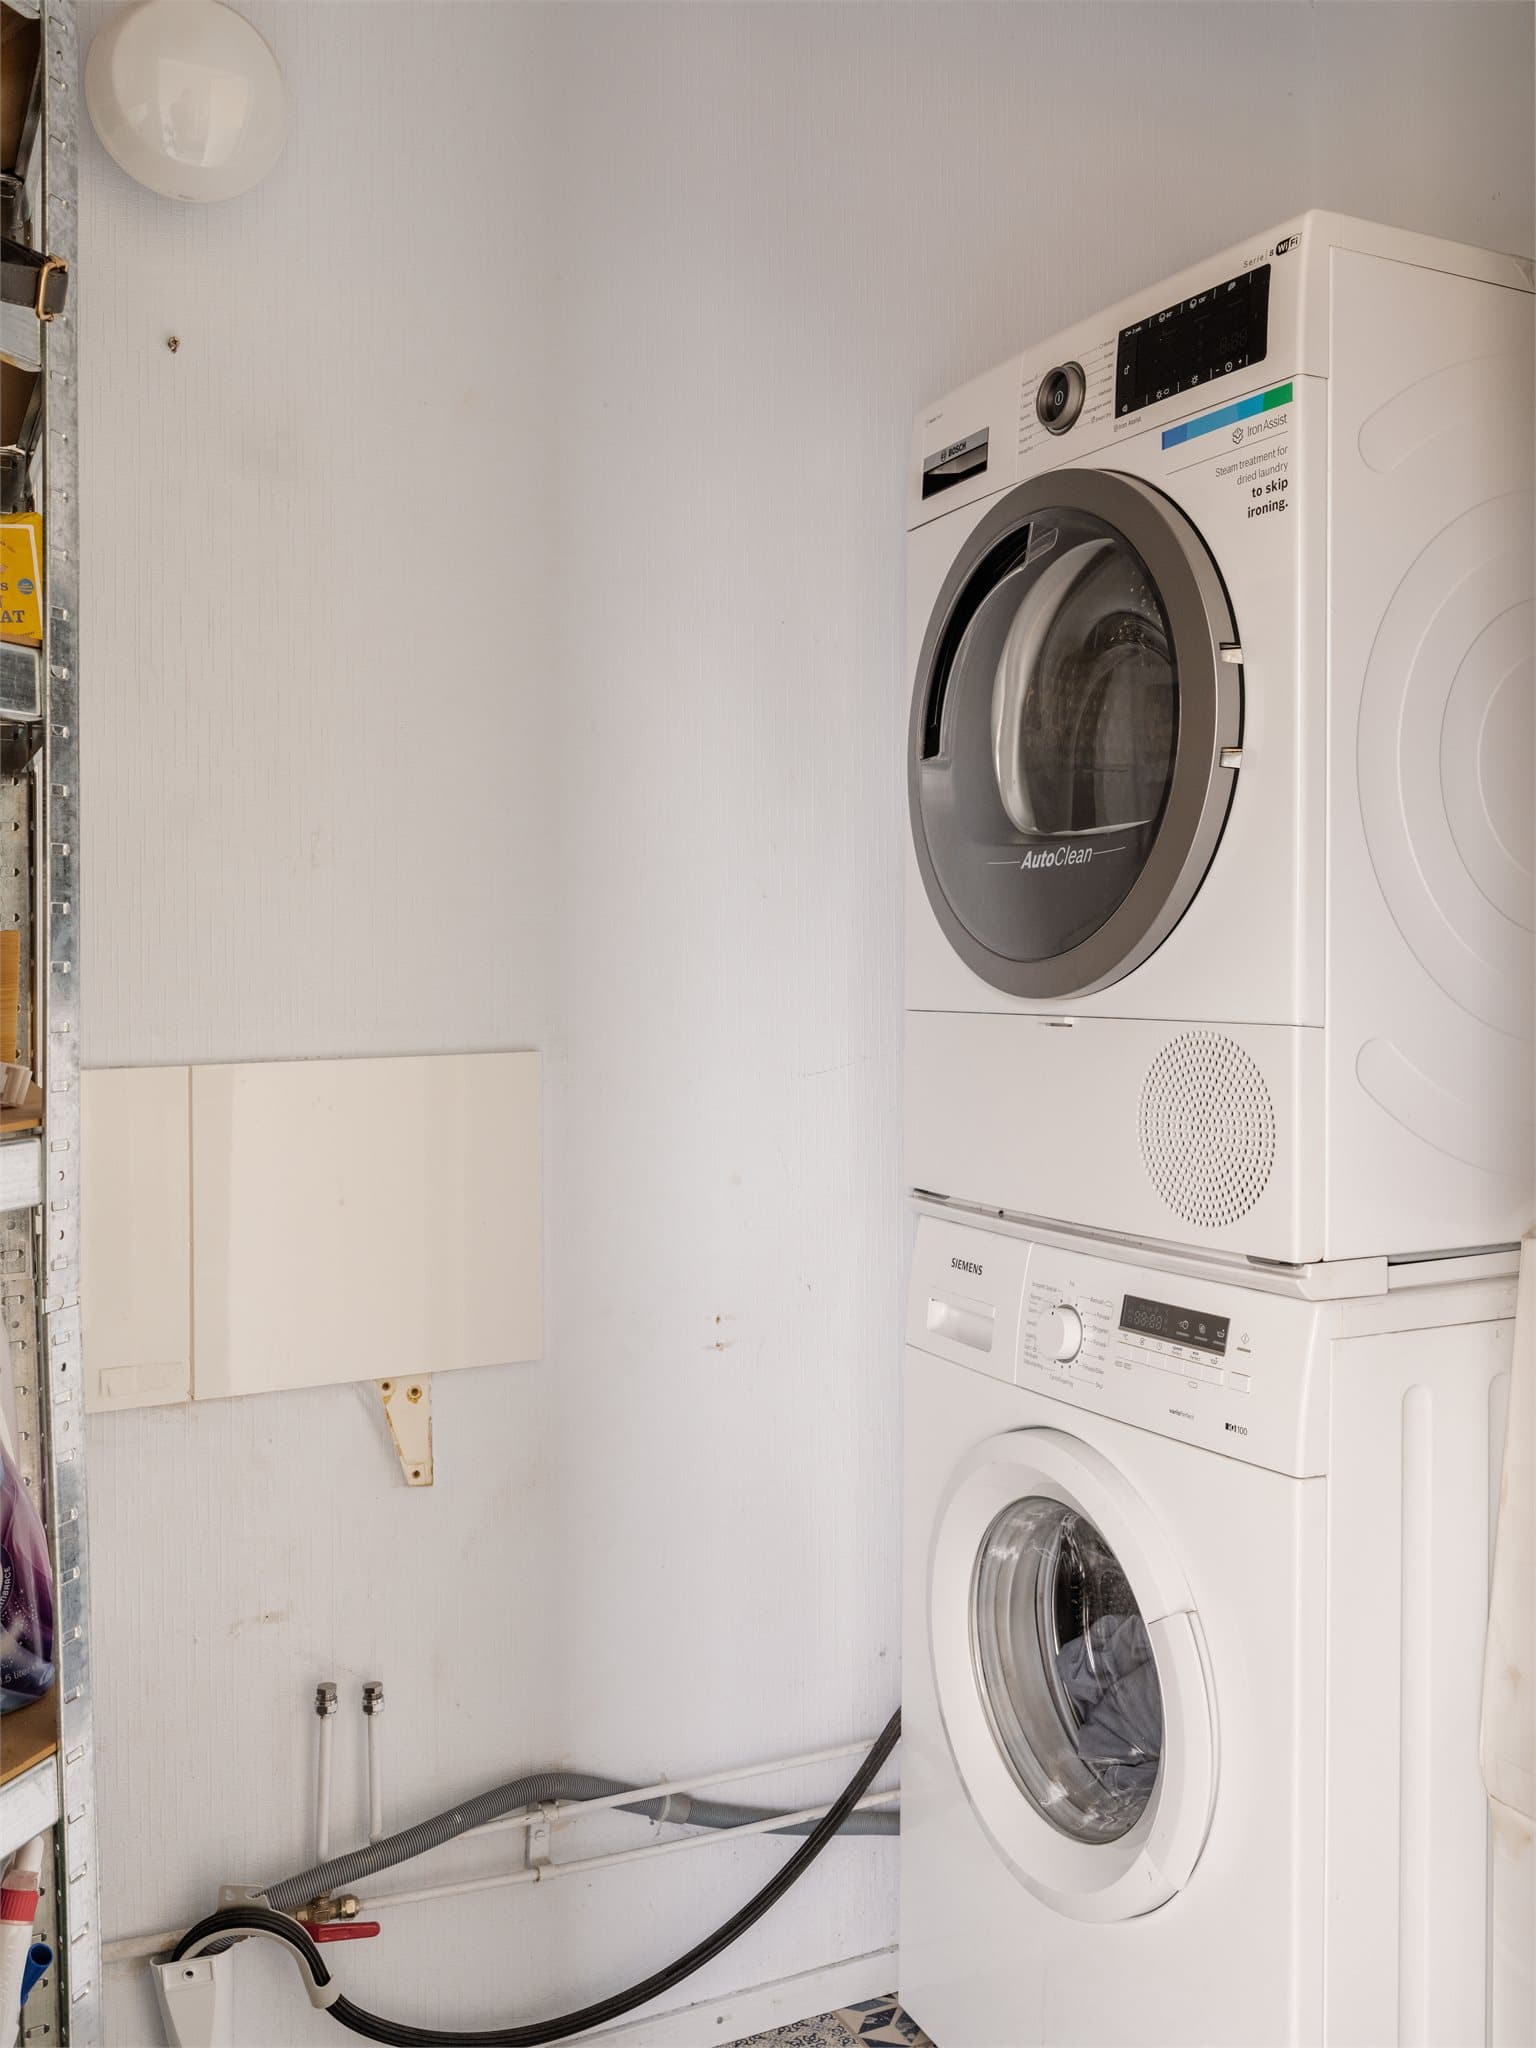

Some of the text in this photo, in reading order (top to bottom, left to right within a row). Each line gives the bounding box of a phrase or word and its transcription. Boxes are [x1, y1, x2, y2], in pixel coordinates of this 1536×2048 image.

[1247, 414, 1287, 437] Iron Assist
[1215, 446, 1288, 478] Steam treatment for
[1236, 462, 1288, 485] dried laundry
[1251, 478, 1288, 498] to skip
[1247, 499, 1288, 518] ironing.
[1020, 845, 1093, 870] AutoClean
[951, 1257, 983, 1276] SIEMENS
